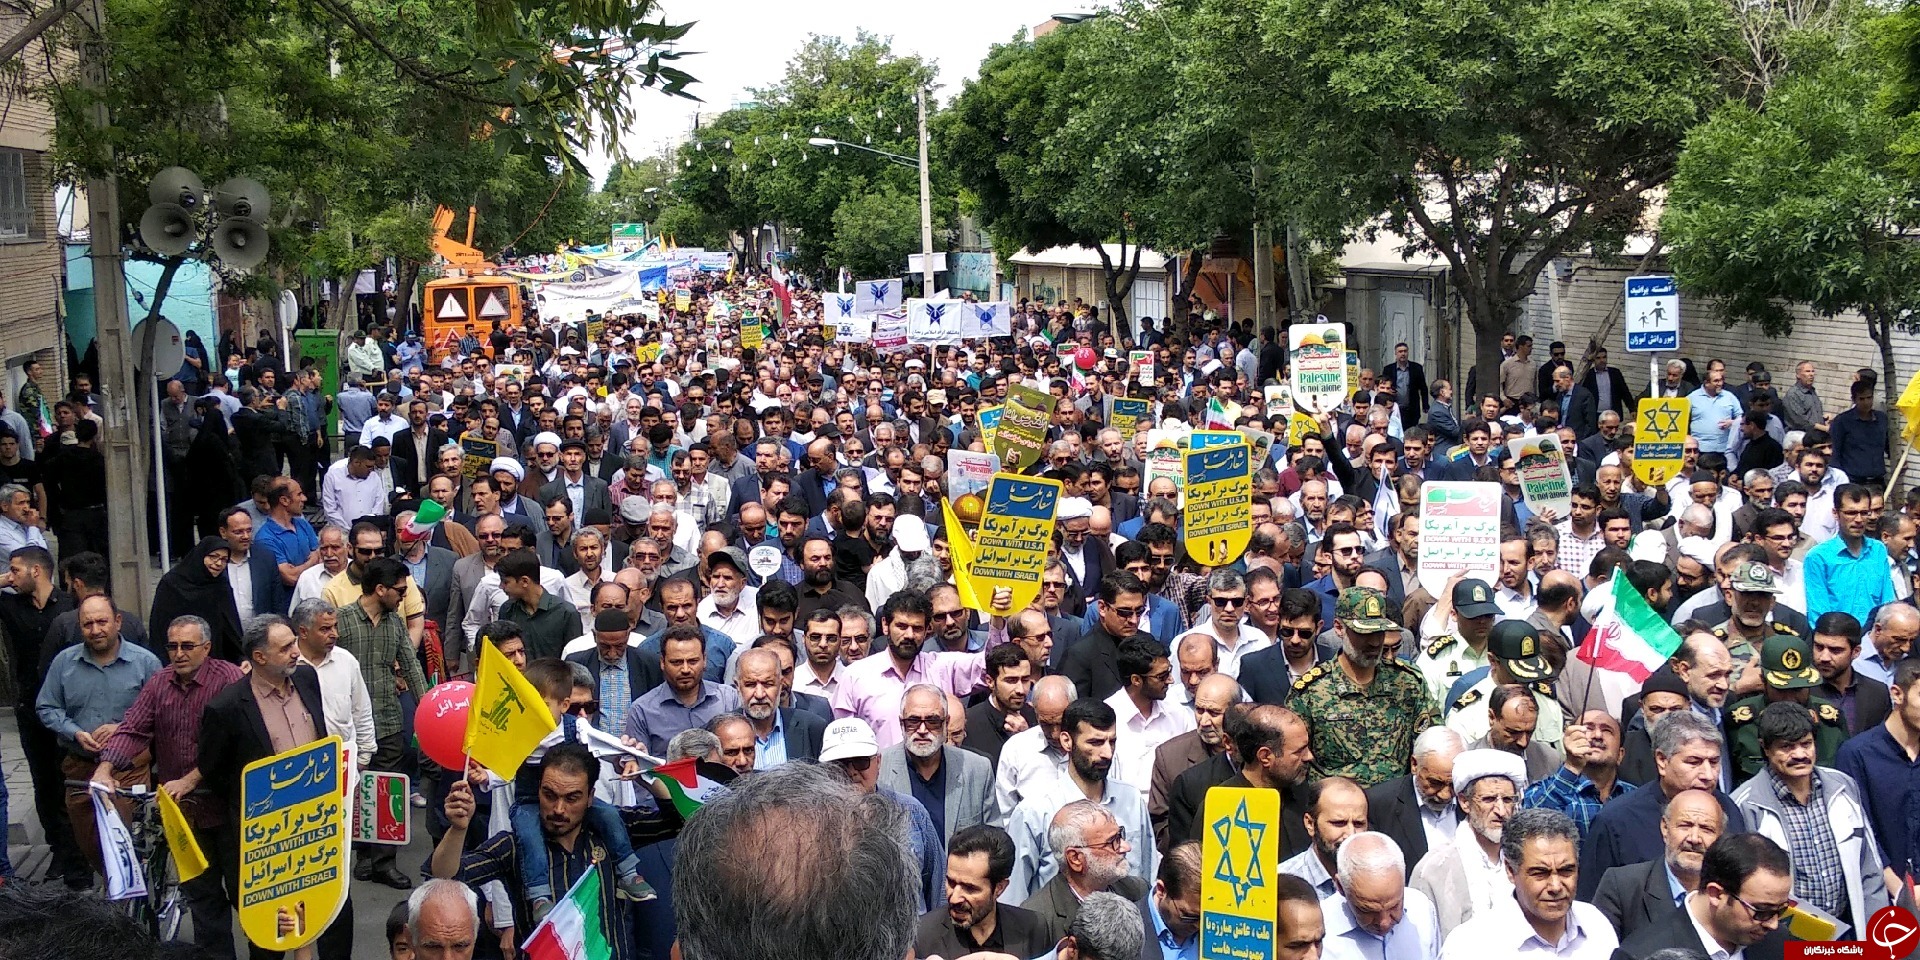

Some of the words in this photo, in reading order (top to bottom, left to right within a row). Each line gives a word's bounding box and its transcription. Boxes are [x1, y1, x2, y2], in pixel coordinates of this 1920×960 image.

[1299, 348, 1339, 363] فلسطین
[1300, 372, 1340, 383] Palestine
[1300, 385, 1306, 393] is
[1308, 385, 1319, 393] not
[1321, 384, 1342, 393] alone
[1204, 450, 1235, 469] ملت
[1227, 450, 1245, 471] شعار
[1009, 485, 1043, 502] ملت
[1188, 482, 1218, 501] آمریکا
[1218, 485, 1227, 498] بر
[1229, 481, 1249, 495] مرگ
[1527, 480, 1567, 493] Palestine
[1031, 490, 1053, 511] شعار
[1189, 502, 1210, 512] DOWN
[1211, 498, 1228, 508] WITH
[1229, 496, 1246, 505] U.S.A
[1530, 493, 1537, 502] is
[1537, 492, 1548, 501] not
[1549, 491, 1569, 500] alone
[1188, 510, 1219, 527] اسرائیل
[1219, 511, 1228, 522] بر
[1231, 505, 1249, 518] مرگ
[983, 517, 1020, 537] آمریکا
[1015, 524, 1027, 539] بر
[1028, 523, 1048, 540] مرگ
[1189, 528, 1209, 538] DOWN
[1209, 525, 1225, 534] WITH
[1226, 522, 1247, 531] ISRAEL
[1425, 517, 1460, 535] آمریکا
[1474, 521, 1496, 535] مرگ
[981, 536, 1004, 546] DOWN
[1005, 539, 1023, 549] WITH
[1023, 541, 1044, 551] U.S.A
[975, 547, 1012, 565] اسرائیل
[1009, 555, 1021, 567] بر
[1023, 553, 1043, 569] مرگ
[974, 567, 996, 577] DOWN
[996, 569, 1014, 579] WITH
[1014, 571, 1037, 581] ISRAEL
[436, 697, 470, 718] اسرائیل
[271, 753, 315, 790] ملت
[304, 752, 331, 788] شعار
[360, 774, 376, 808] آمریکا
[307, 801, 338, 826] مرگ
[361, 806, 372, 817] بر
[244, 808, 291, 845] آمریکا
[290, 812, 305, 836] بر
[360, 818, 374, 840] مرگ
[247, 844, 277, 862] DOWN
[279, 835, 305, 851] WITH
[307, 828, 334, 843] U.S.A
[309, 844, 338, 866] مرگ
[244, 853, 292, 889] اسرائیل
[293, 855, 306, 876] بر
[245, 887, 274, 905] DOWN
[275, 878, 300, 895] WITH
[301, 869, 334, 888] ISRAEL
[1211, 919, 1232, 937] مبارزه
[1233, 922, 1251, 939] عاشق
